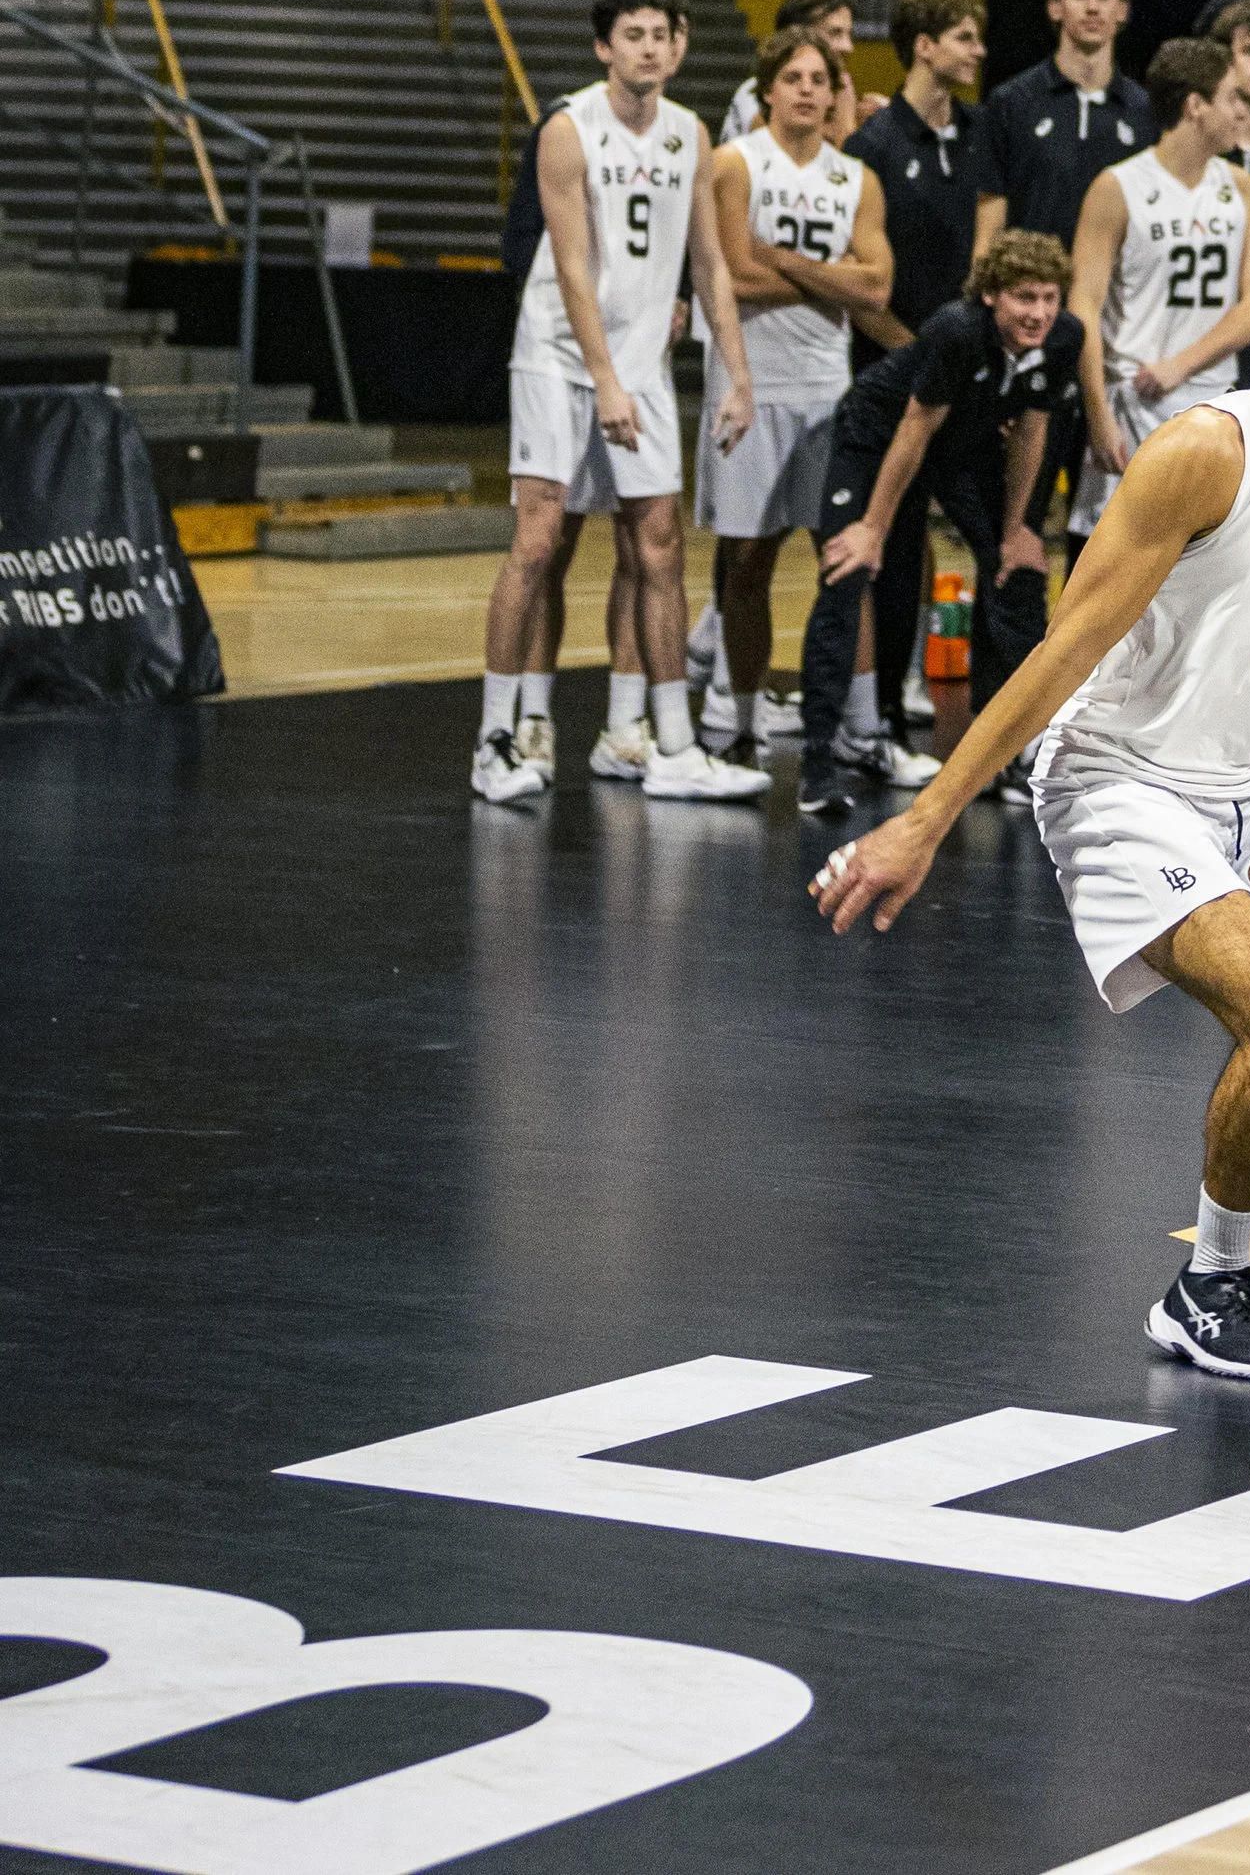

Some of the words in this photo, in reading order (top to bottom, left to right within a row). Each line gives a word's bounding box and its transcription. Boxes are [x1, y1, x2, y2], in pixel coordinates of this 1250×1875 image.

[601, 165, 682, 191] BEACH
[761, 187, 848, 219] BEACH
[626, 192, 651, 259] 9
[776, 214, 835, 263] 25
[1150, 216, 1236, 243] BEACH
[1166, 242, 1228, 309] 22
